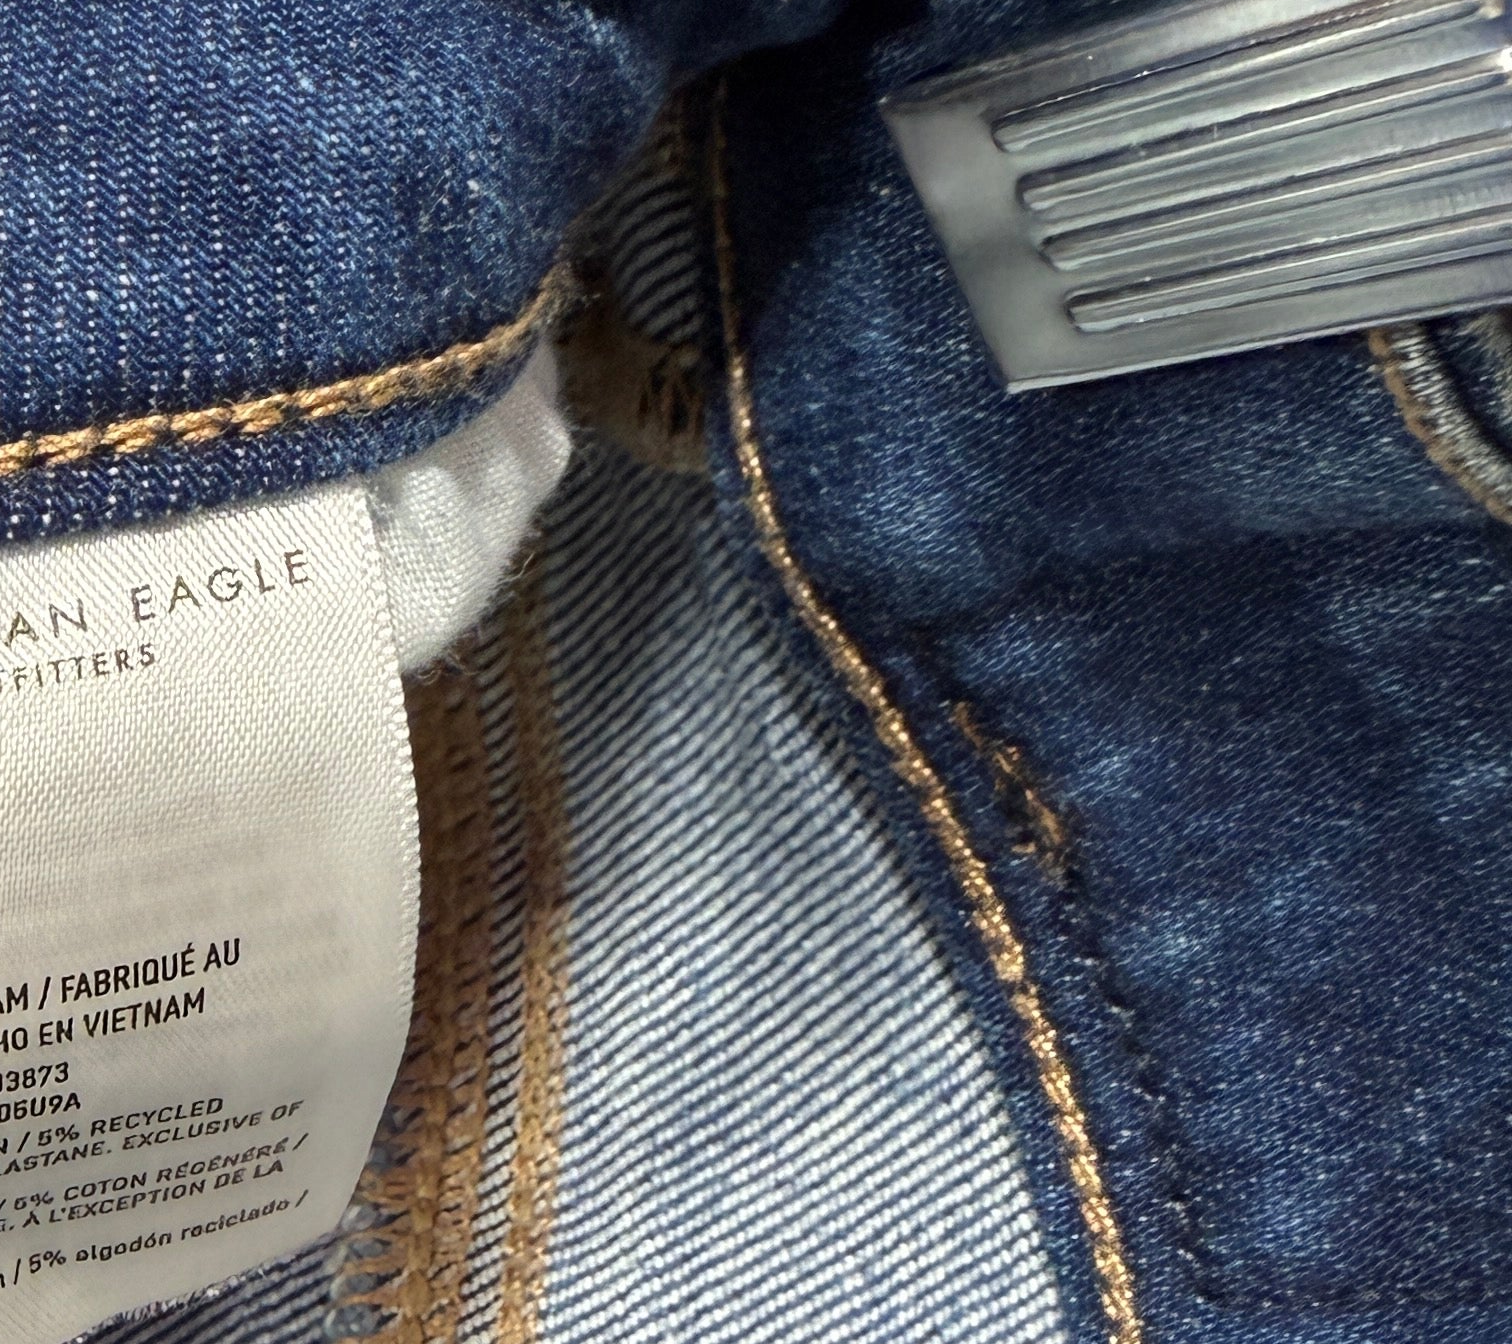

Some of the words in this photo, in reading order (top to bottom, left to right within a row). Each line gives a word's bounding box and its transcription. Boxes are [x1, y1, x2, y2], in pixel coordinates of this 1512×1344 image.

[131, 549, 311, 622] EAGLE
[37, 976, 51, 1010] /
[61, 942, 196, 1004] FABRIQUÉ
[202, 938, 241, 973] AU
[39, 1017, 74, 1047] EN
[83, 986, 206, 1038] VIETNAM
[17, 1131, 31, 1153] /
[38, 1123, 80, 1148] 5%
[90, 1097, 224, 1137] RECYCLED
[121, 1110, 263, 1152] EXCLUSIVE
[270, 1099, 305, 1122] OF
[63, 1171, 148, 1203] COTON
[292, 1131, 310, 1151] /
[213, 1167, 247, 1191] DE
[252, 1158, 286, 1180] LA
[12, 1257, 23, 1286] /
[29, 1248, 68, 1274] 5%
[74, 1231, 173, 1263] algodón
[294, 1188, 310, 1208] /
